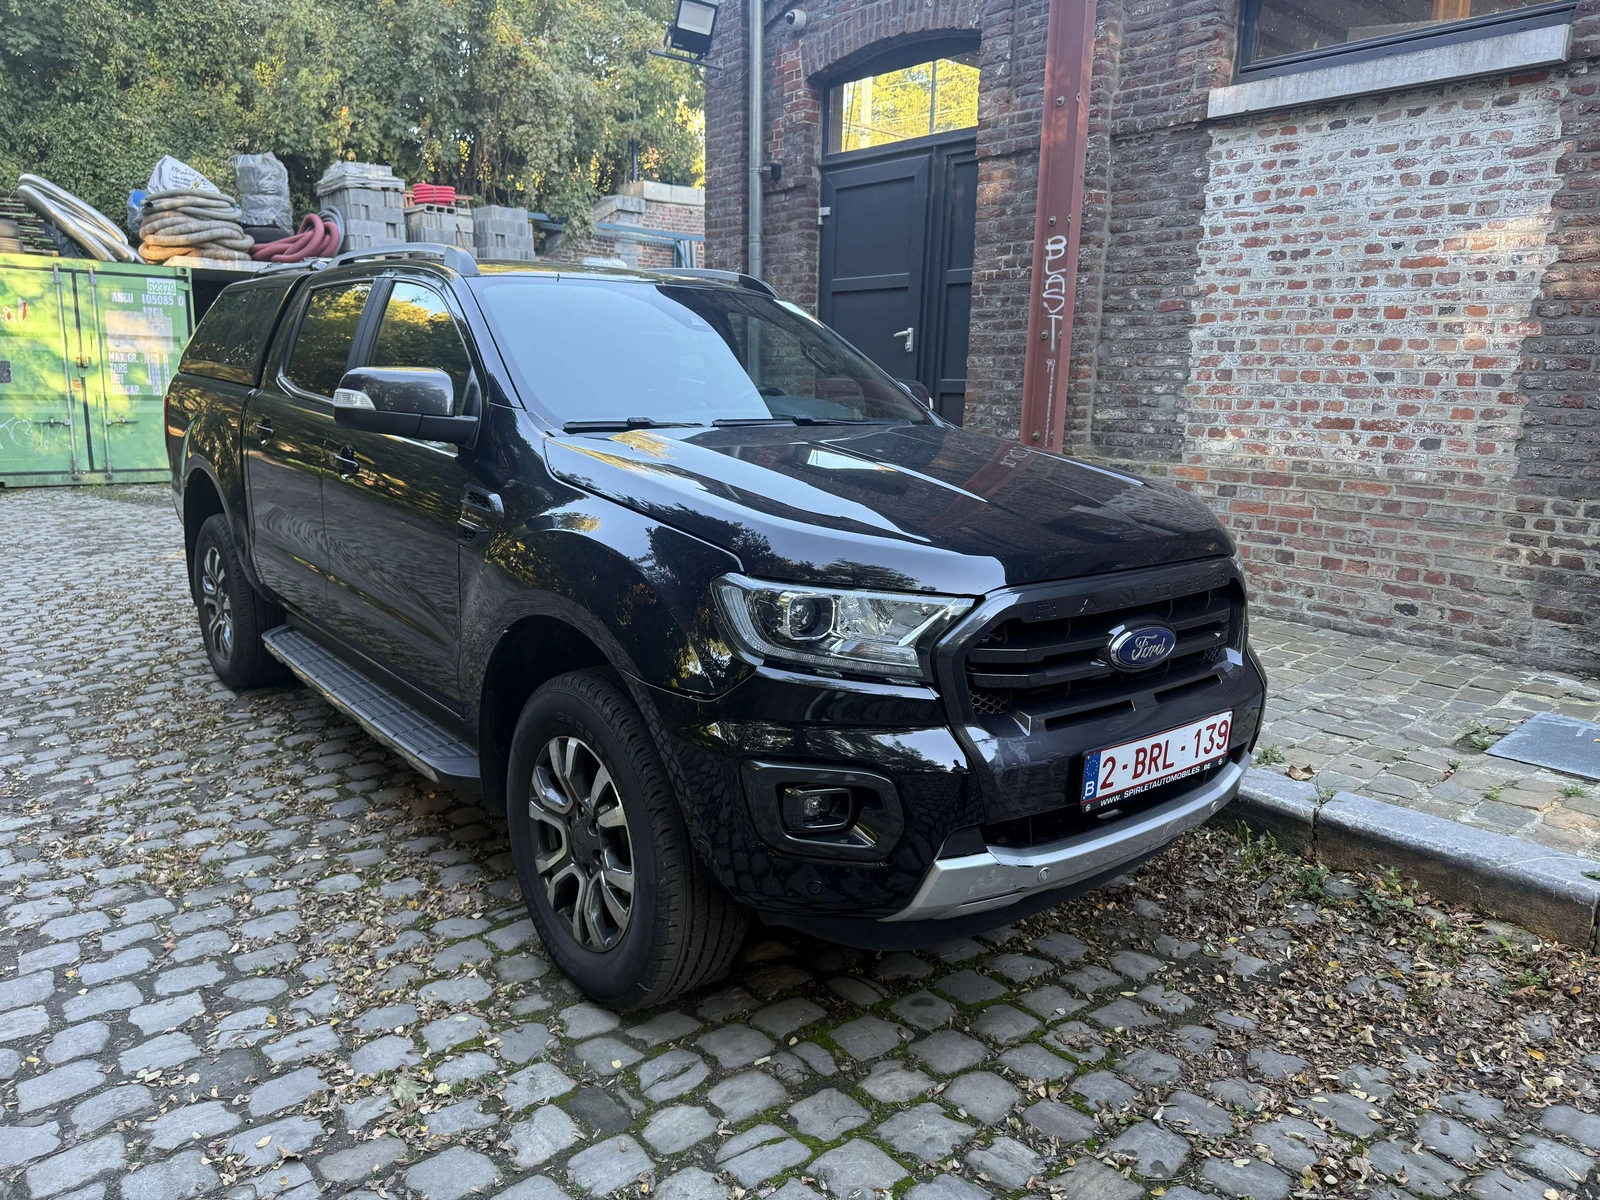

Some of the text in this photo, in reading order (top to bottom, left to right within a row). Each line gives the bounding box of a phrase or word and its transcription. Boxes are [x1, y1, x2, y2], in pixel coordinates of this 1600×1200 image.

[147, 282, 175, 294] 62379
[111, 292, 134, 304] ANCU
[142, 293, 174, 306] 105085
[109, 363, 128, 374] TARE
[110, 374, 124, 385] NET
[1131, 634, 1165, 660] Ford
[1085, 781, 1095, 797] B
